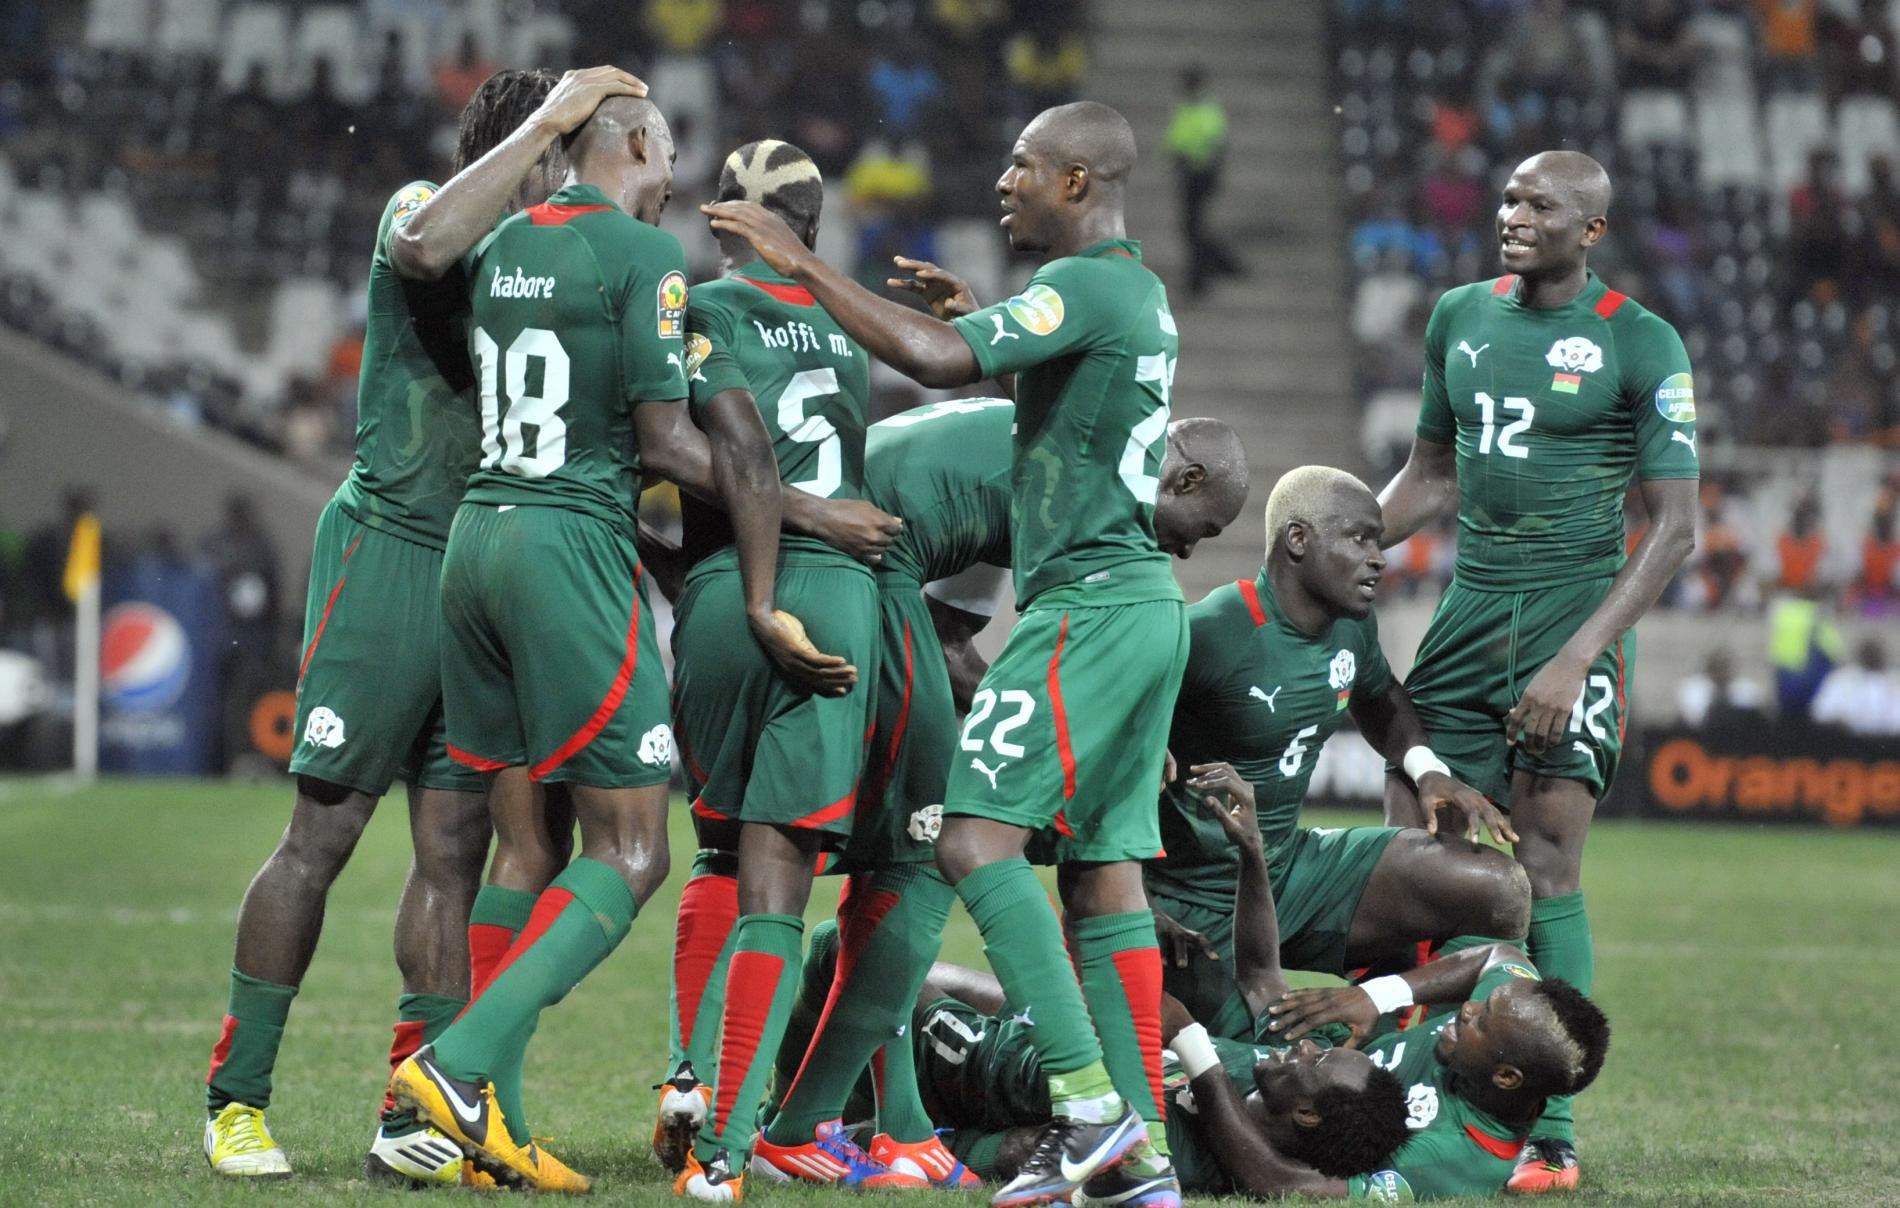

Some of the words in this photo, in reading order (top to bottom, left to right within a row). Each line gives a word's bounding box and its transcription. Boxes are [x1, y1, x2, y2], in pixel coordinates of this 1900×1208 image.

[490, 265, 555, 298] kabore
[753, 320, 820, 352] koffi
[828, 333, 853, 357] m.
[474, 327, 570, 478] 18
[777, 367, 842, 499] 5
[1474, 391, 1536, 459] 12
[960, 688, 1037, 759] 22
[1279, 724, 1319, 778] 6
